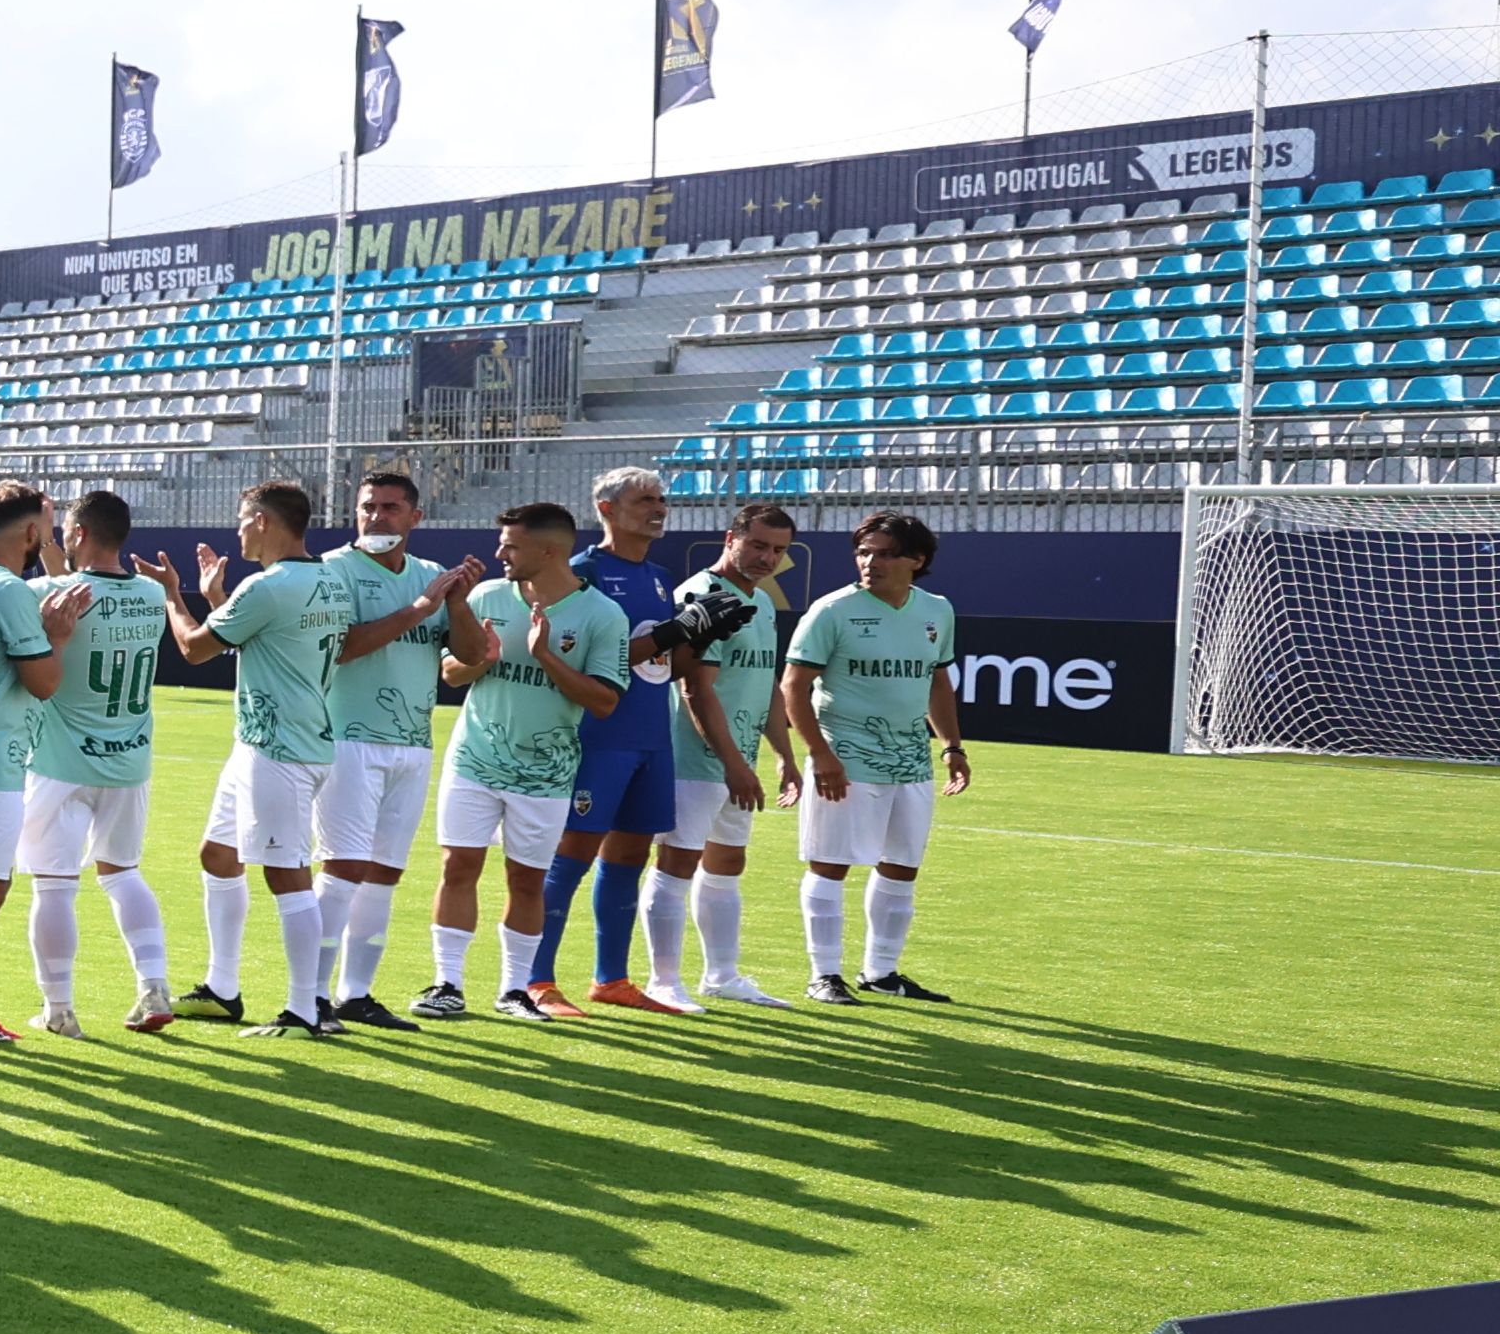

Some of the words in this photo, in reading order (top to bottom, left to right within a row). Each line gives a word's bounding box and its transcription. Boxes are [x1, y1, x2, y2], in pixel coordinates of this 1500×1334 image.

[940, 174, 987, 201] LIGA
[994, 159, 1111, 196] PORTUGAL
[252, 221, 393, 283] JOGAM
[403, 214, 463, 267] NA
[479, 186, 675, 262] NAZARÉ
[64, 254, 96, 275] NUM
[98, 246, 173, 273] UNIVERSO
[176, 243, 199, 264] EM
[101, 273, 131, 298] QUE
[133, 272, 155, 293] AS
[158, 263, 236, 290] ESTRELAS
[120, 597, 146, 607] EVA
[334, 593, 350, 603] SENS
[121, 606, 165, 617] SENSES
[300, 611, 338, 630] BRUNO
[91, 628, 100, 643] F.
[108, 624, 158, 643] TEIXEIRA
[89, 646, 155, 718] 40
